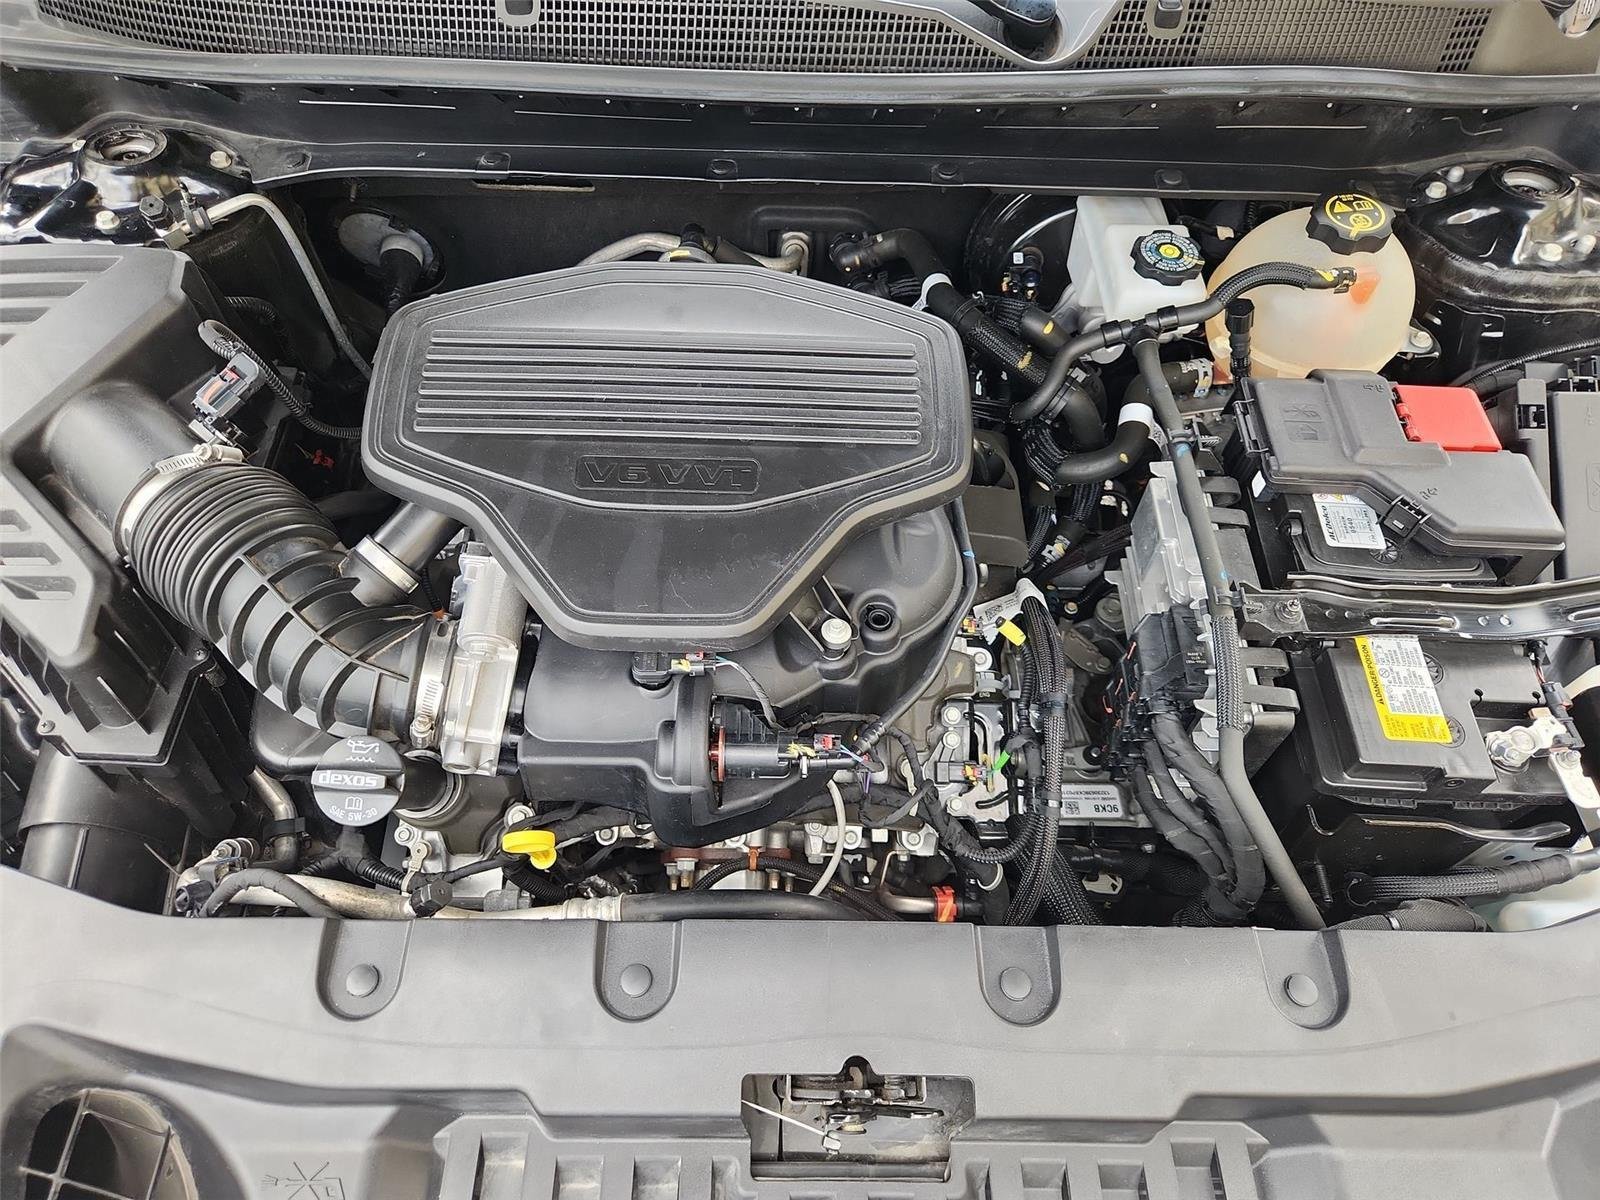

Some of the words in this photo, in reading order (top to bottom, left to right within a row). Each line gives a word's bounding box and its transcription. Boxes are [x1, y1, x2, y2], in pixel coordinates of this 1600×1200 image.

[583, 461, 651, 484] V6
[657, 463, 752, 486] VVT
[318, 770, 377, 787] dexos
[329, 805, 345, 819] SAE
[1093, 804, 1119, 813] 9CKB
